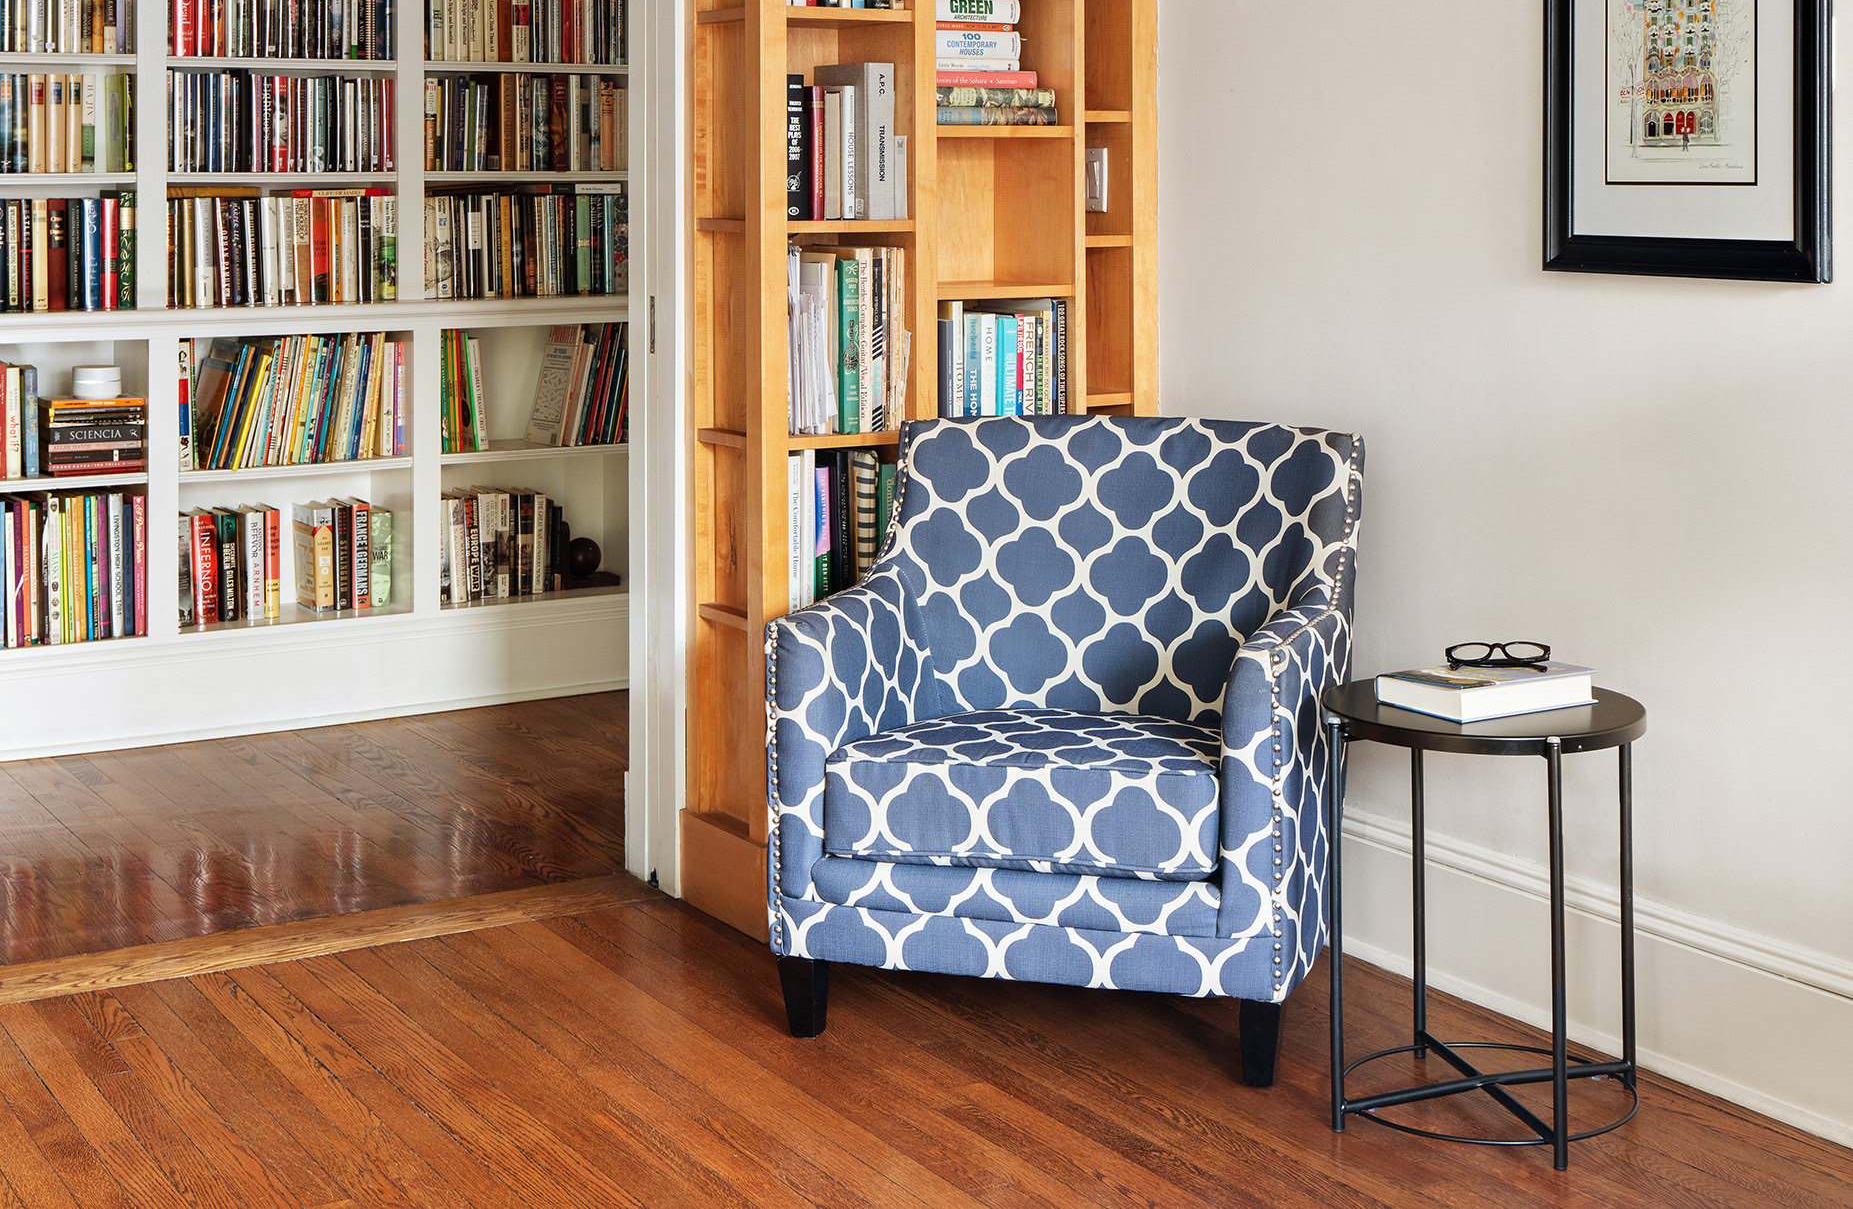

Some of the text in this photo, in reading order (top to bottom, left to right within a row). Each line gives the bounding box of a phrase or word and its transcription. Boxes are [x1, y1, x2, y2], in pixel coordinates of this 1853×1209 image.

[946, 40, 997, 49] CONTEMPORARY
[959, 48, 984, 56] HOUSES
[962, 33, 981, 41] 100
[860, 260, 868, 276] The
[859, 340, 868, 389] Guitar/Vocal
[1005, 361, 1016, 404] ULTIMATE
[1025, 321, 1034, 415] FRENCH RIV
[1060, 372, 1066, 380] OF
[9, 415, 19, 453] what if?
[69, 430, 122, 441] SCIENCIA
[792, 491, 800, 505] The
[250, 522, 258, 558] BEEVOR
[792, 506, 800, 553] Comfortable
[51, 551, 59, 580] MASKS
[200, 532, 212, 591] INFERNO
[340, 540, 348, 592] STALINGRAD
[356, 511, 368, 595] FRANCE GERMANS
[372, 551, 389, 561] WAR
[470, 528, 480, 590] EUROPE WAR
